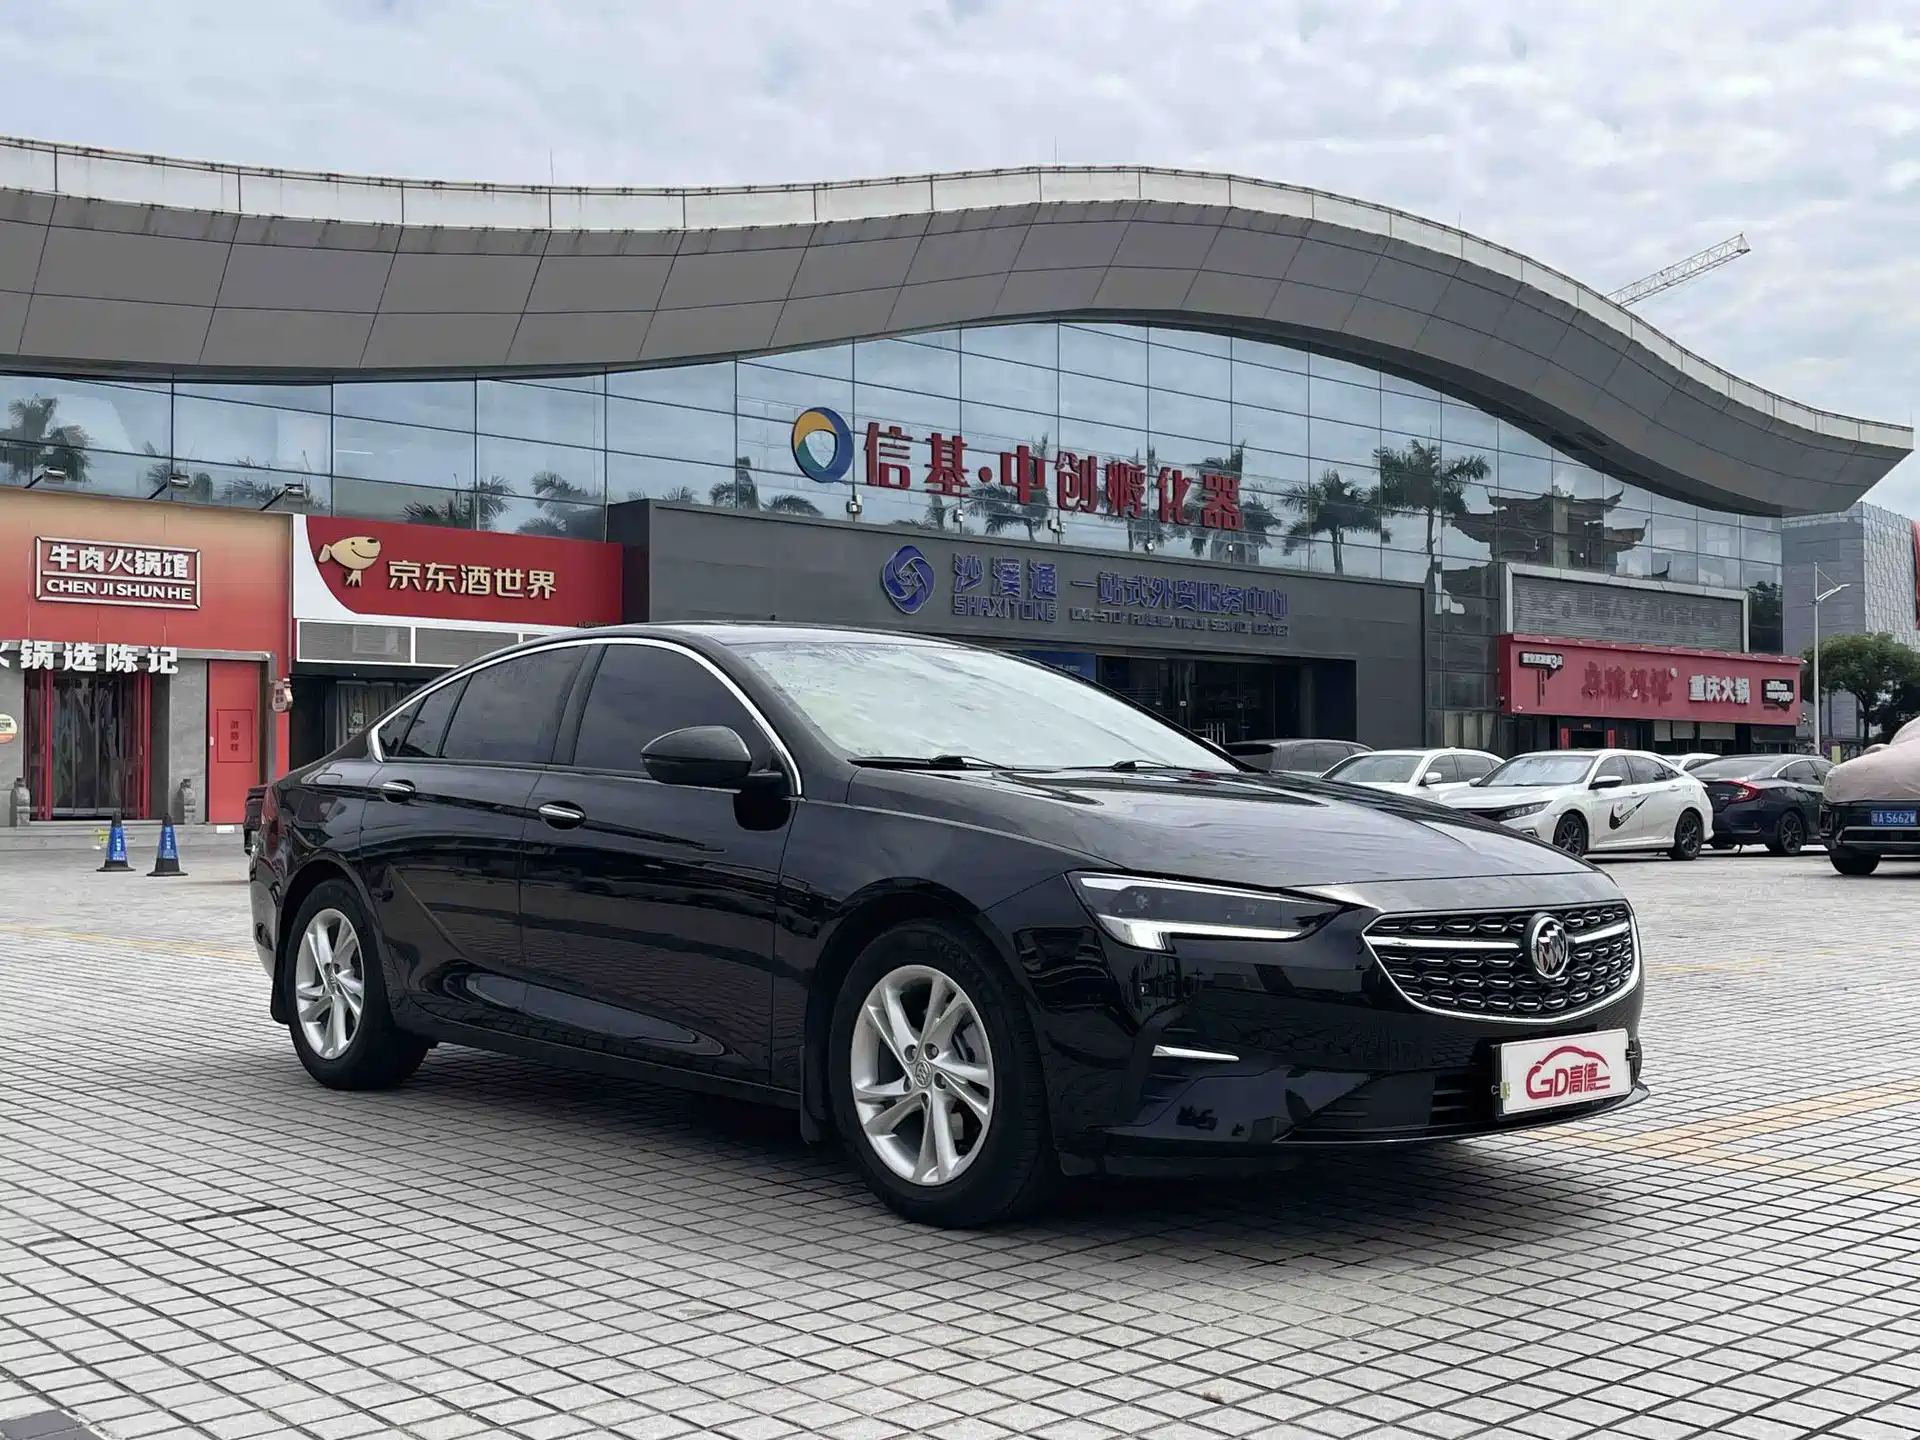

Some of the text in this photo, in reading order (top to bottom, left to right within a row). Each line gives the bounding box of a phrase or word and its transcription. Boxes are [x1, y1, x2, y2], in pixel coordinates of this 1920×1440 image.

[863, 422, 1243, 530] 信基·中创孵化器
[49, 544, 189, 579] 牛肉火锅馆
[387, 559, 558, 601] 京东酒世界
[953, 552, 1058, 599] 沙溪通
[46, 579, 193, 601] CHEN JI SHUN HE
[953, 594, 1058, 623] SHAXITONG
[1069, 571, 1288, 620] 一站式外贸服务中心
[1689, 674, 1750, 704] 重庆火锅
